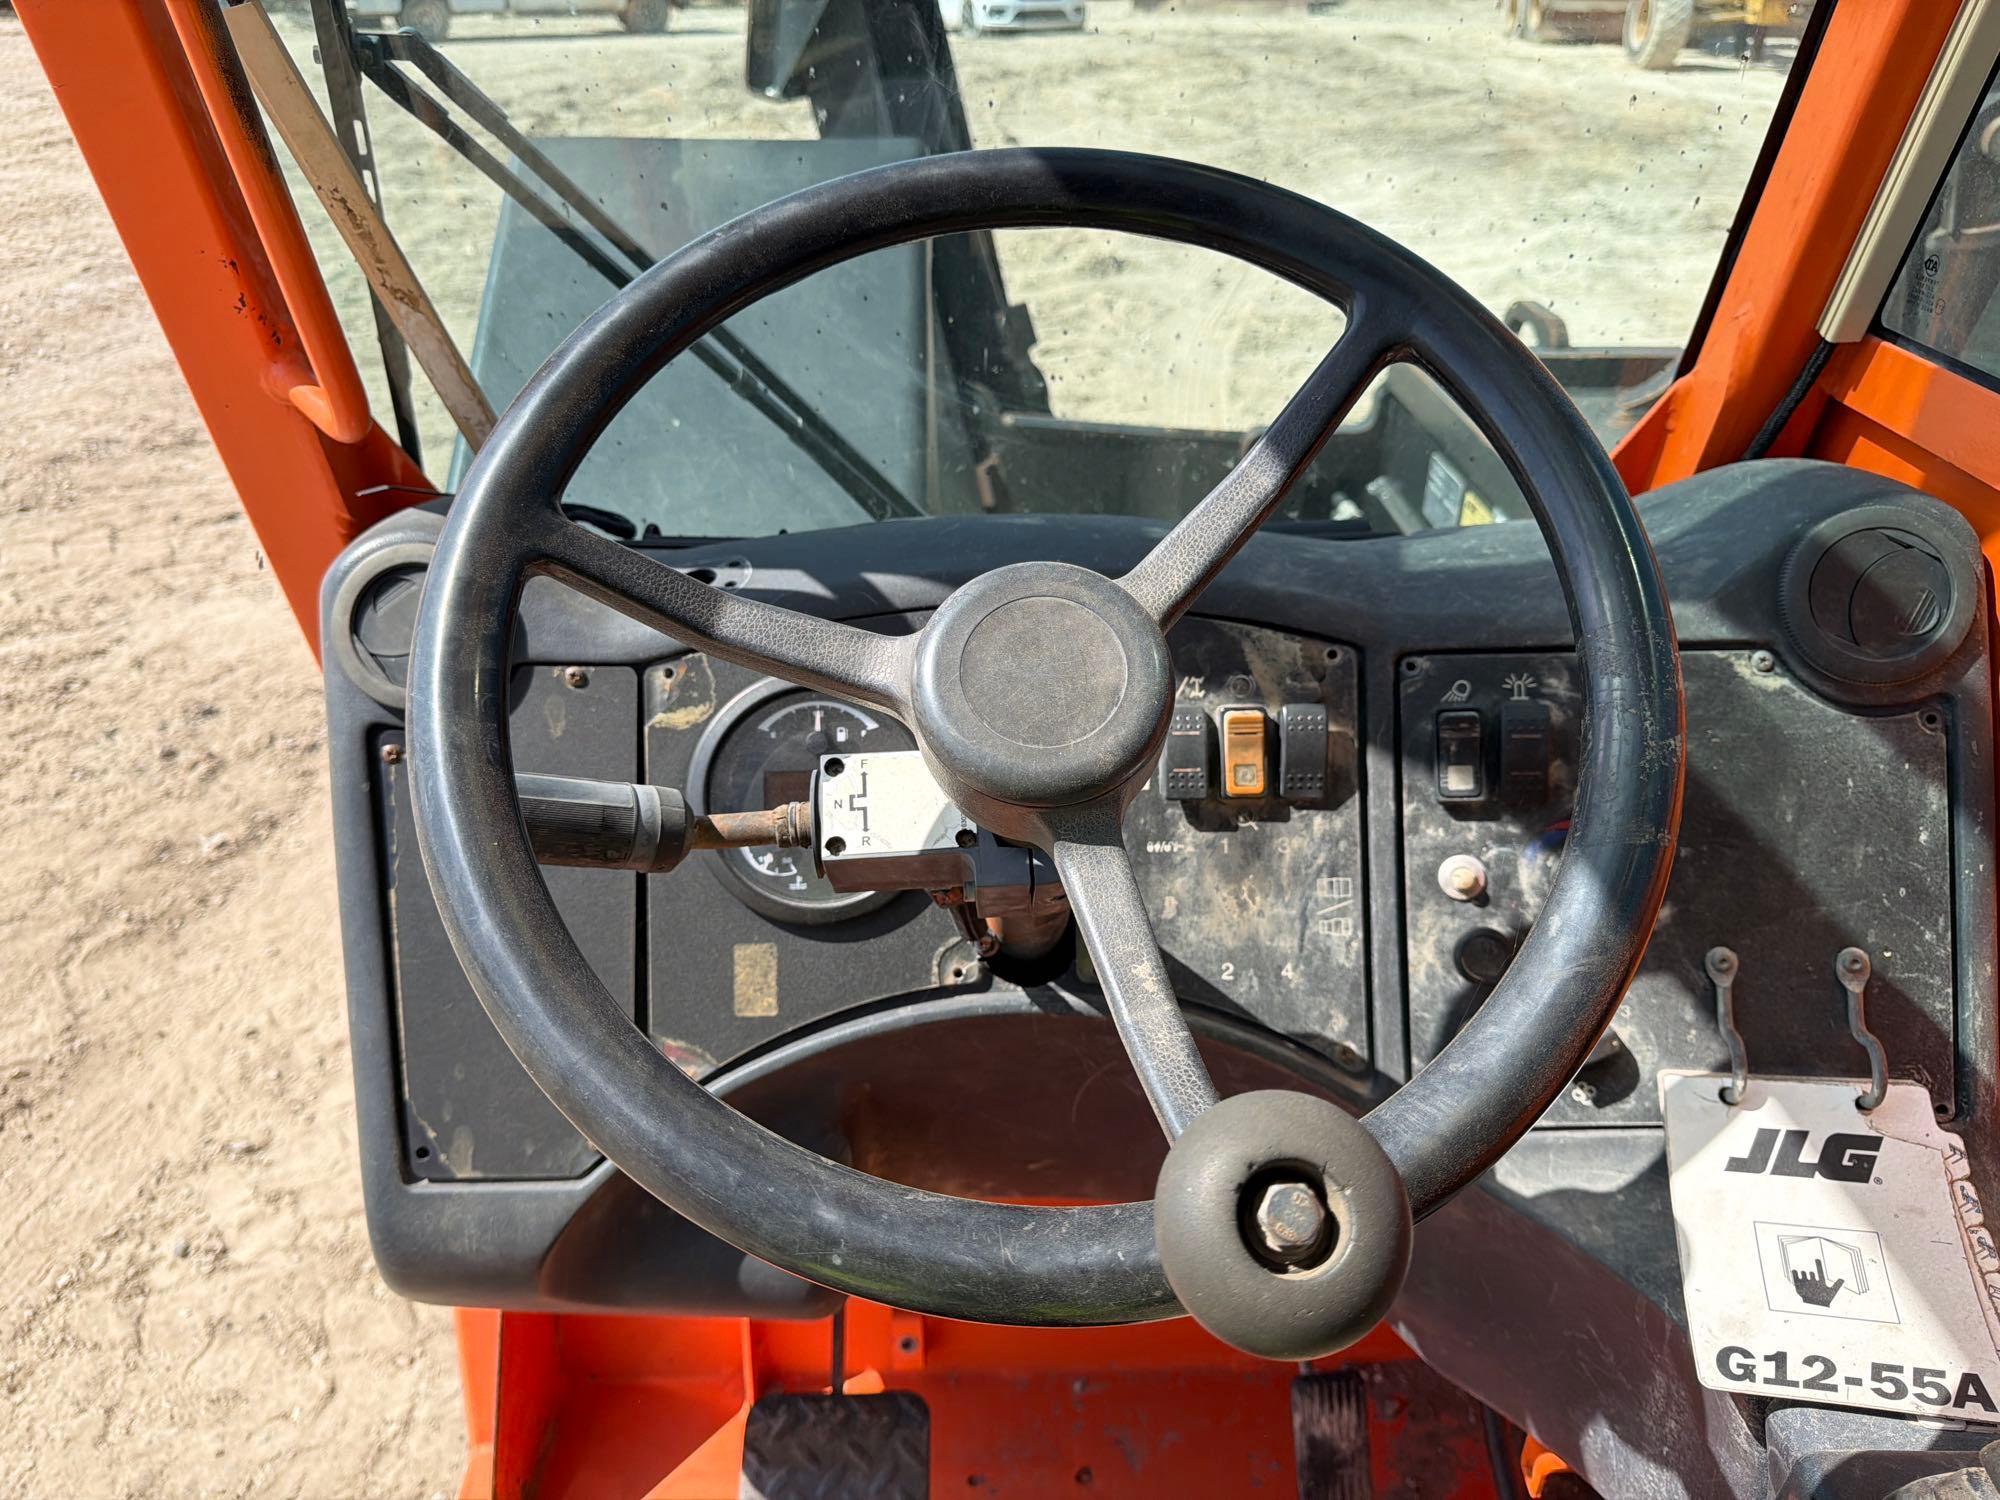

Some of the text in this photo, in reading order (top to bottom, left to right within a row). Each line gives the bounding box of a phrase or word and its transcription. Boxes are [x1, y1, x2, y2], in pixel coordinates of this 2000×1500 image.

[861, 759, 869, 769] F
[834, 799, 843, 809] N
[862, 836, 871, 846] R
[1221, 962, 1235, 981] 2
[1281, 962, 1295, 980] 4
[1724, 1127, 1884, 1184] JLG
[1715, 1345, 1999, 1414] G12-55A
